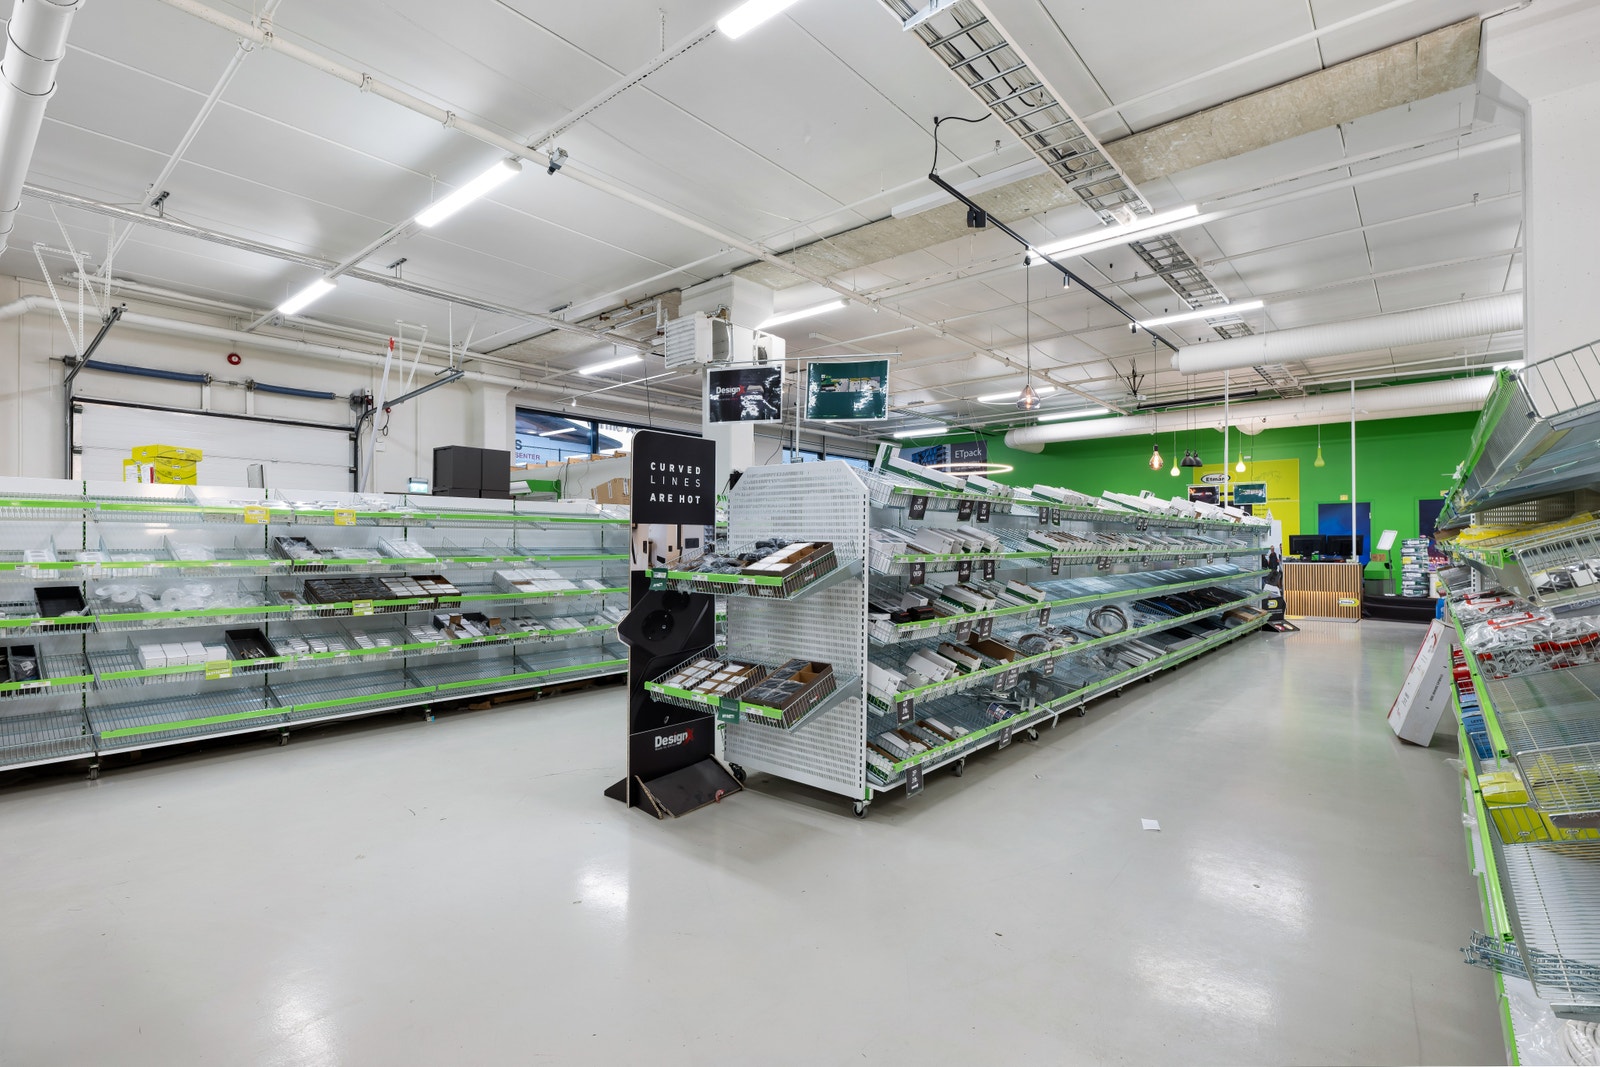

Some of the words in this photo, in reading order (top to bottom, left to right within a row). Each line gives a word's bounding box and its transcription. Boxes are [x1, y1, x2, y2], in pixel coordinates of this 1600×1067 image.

[954, 447, 982, 460] ETpack
[650, 461, 701, 475] CURVED
[650, 475, 701, 487] LINES
[649, 492, 673, 503] ARE
[679, 494, 701, 504] HOT
